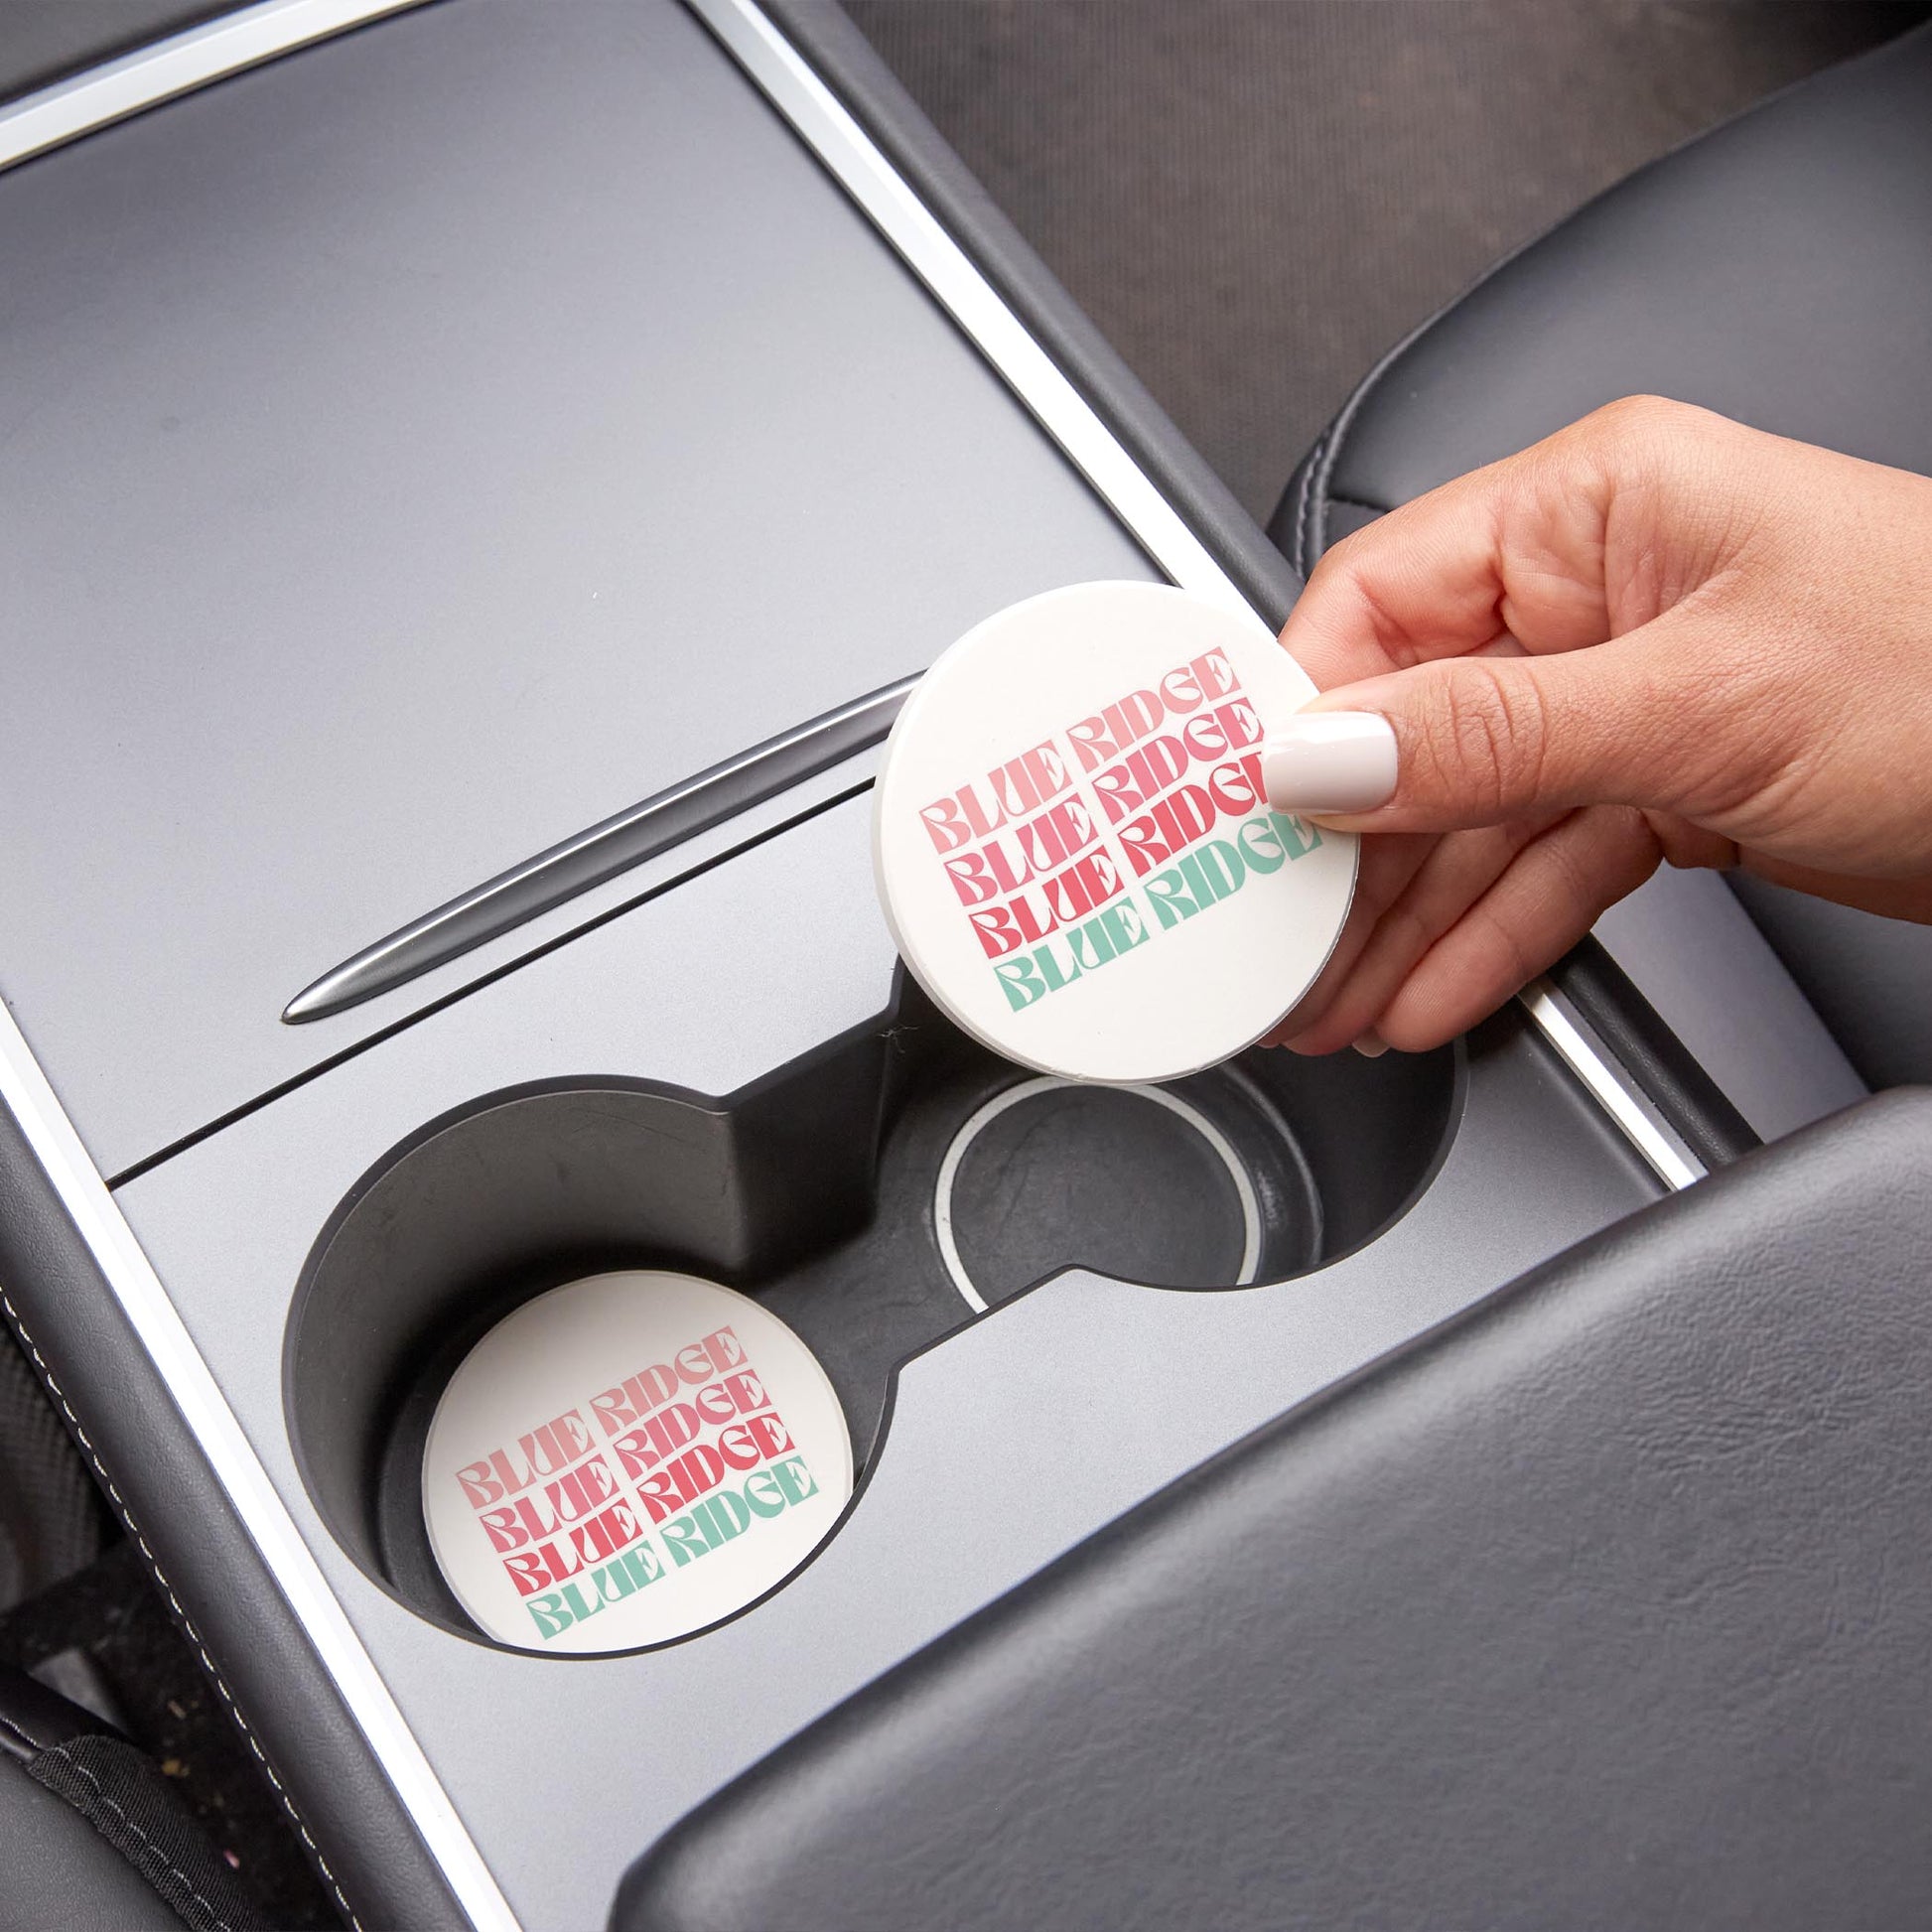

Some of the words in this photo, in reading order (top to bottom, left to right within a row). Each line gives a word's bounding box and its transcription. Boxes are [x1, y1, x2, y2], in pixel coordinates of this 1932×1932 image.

[918, 740, 1072, 855] BLUE
[1065, 646, 1242, 773] RIDGE
[943, 793, 1098, 906] BLUE
[1091, 697, 1265, 825] RIDGE
[968, 845, 1125, 960] BLUE
[994, 897, 1150, 1013] BLUE
[1143, 811, 1322, 930] RIDGE
[456, 1409, 596, 1510] BLUE
[590, 1325, 749, 1438] RIDGE
[479, 1453, 621, 1554] BLUE
[613, 1369, 771, 1480] RIDGE
[502, 1498, 643, 1596] BLUE
[636, 1412, 795, 1524] RIDGE
[525, 1541, 665, 1640] BLUE
[661, 1454, 819, 1568] RIDGE
